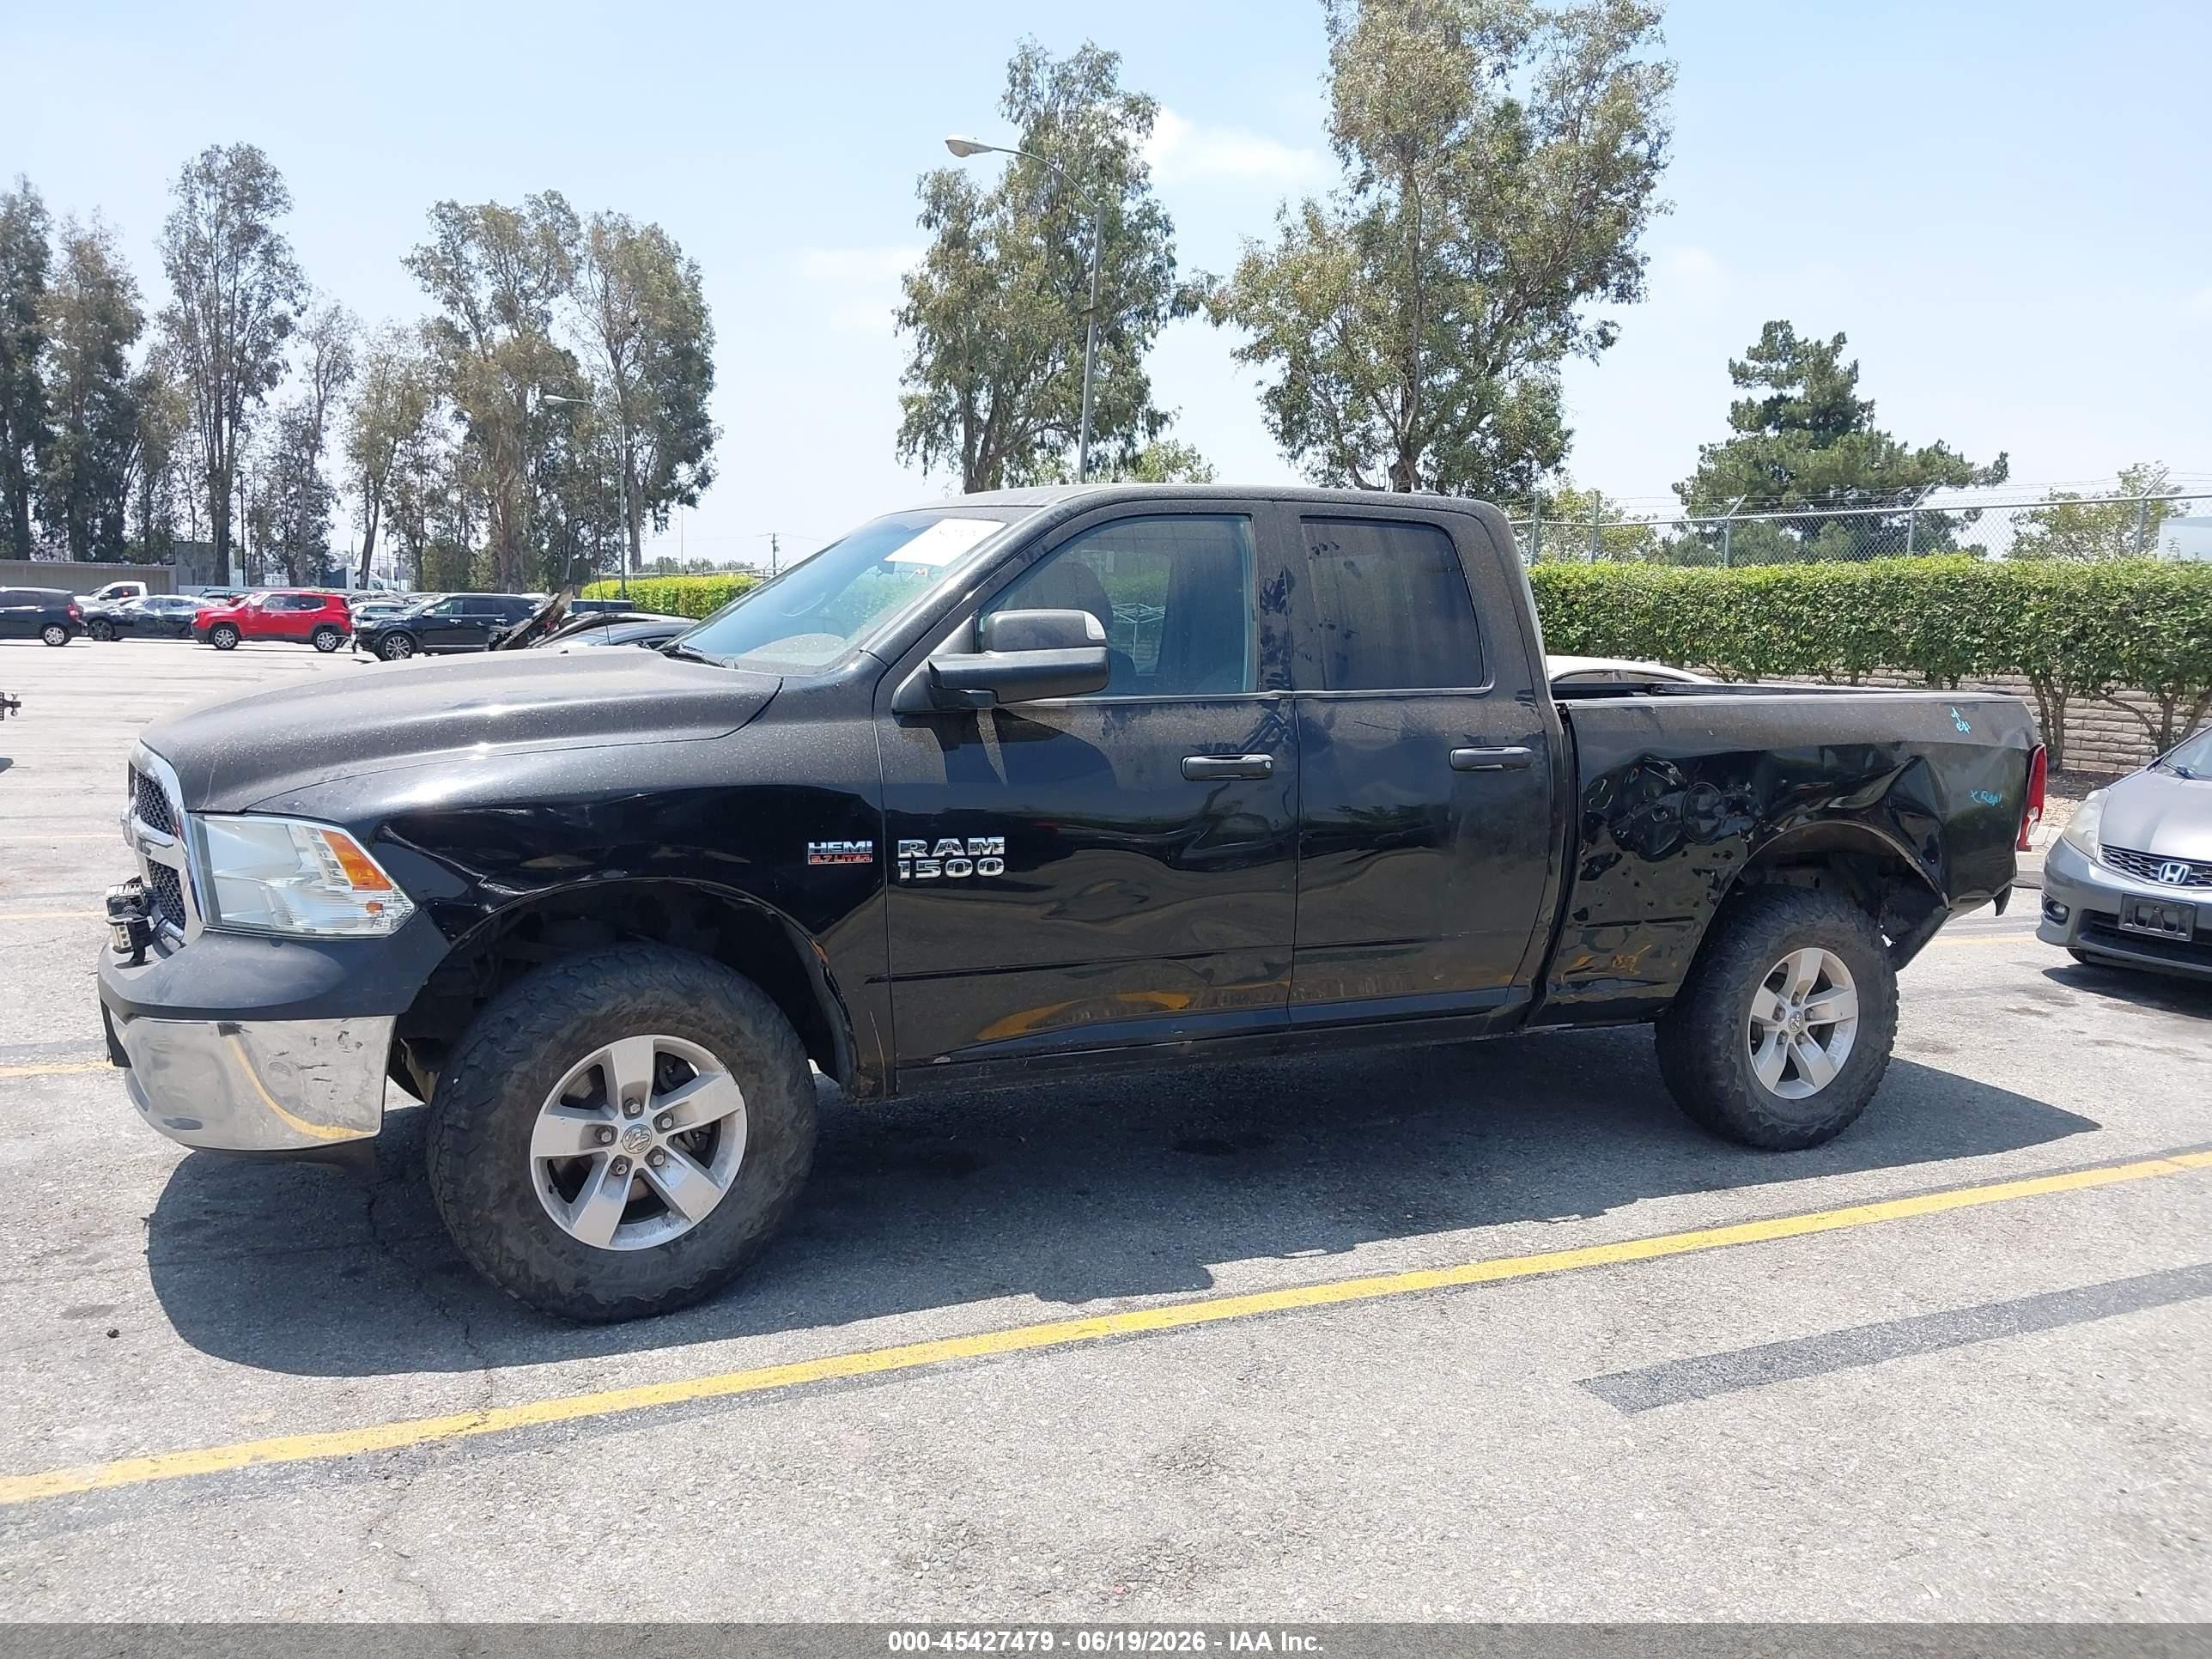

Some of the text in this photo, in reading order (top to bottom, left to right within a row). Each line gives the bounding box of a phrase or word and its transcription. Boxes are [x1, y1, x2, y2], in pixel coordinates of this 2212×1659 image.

[808, 841, 872, 854] HEMI
[897, 836, 1005, 858] RAM
[898, 857, 1005, 879] 1500
